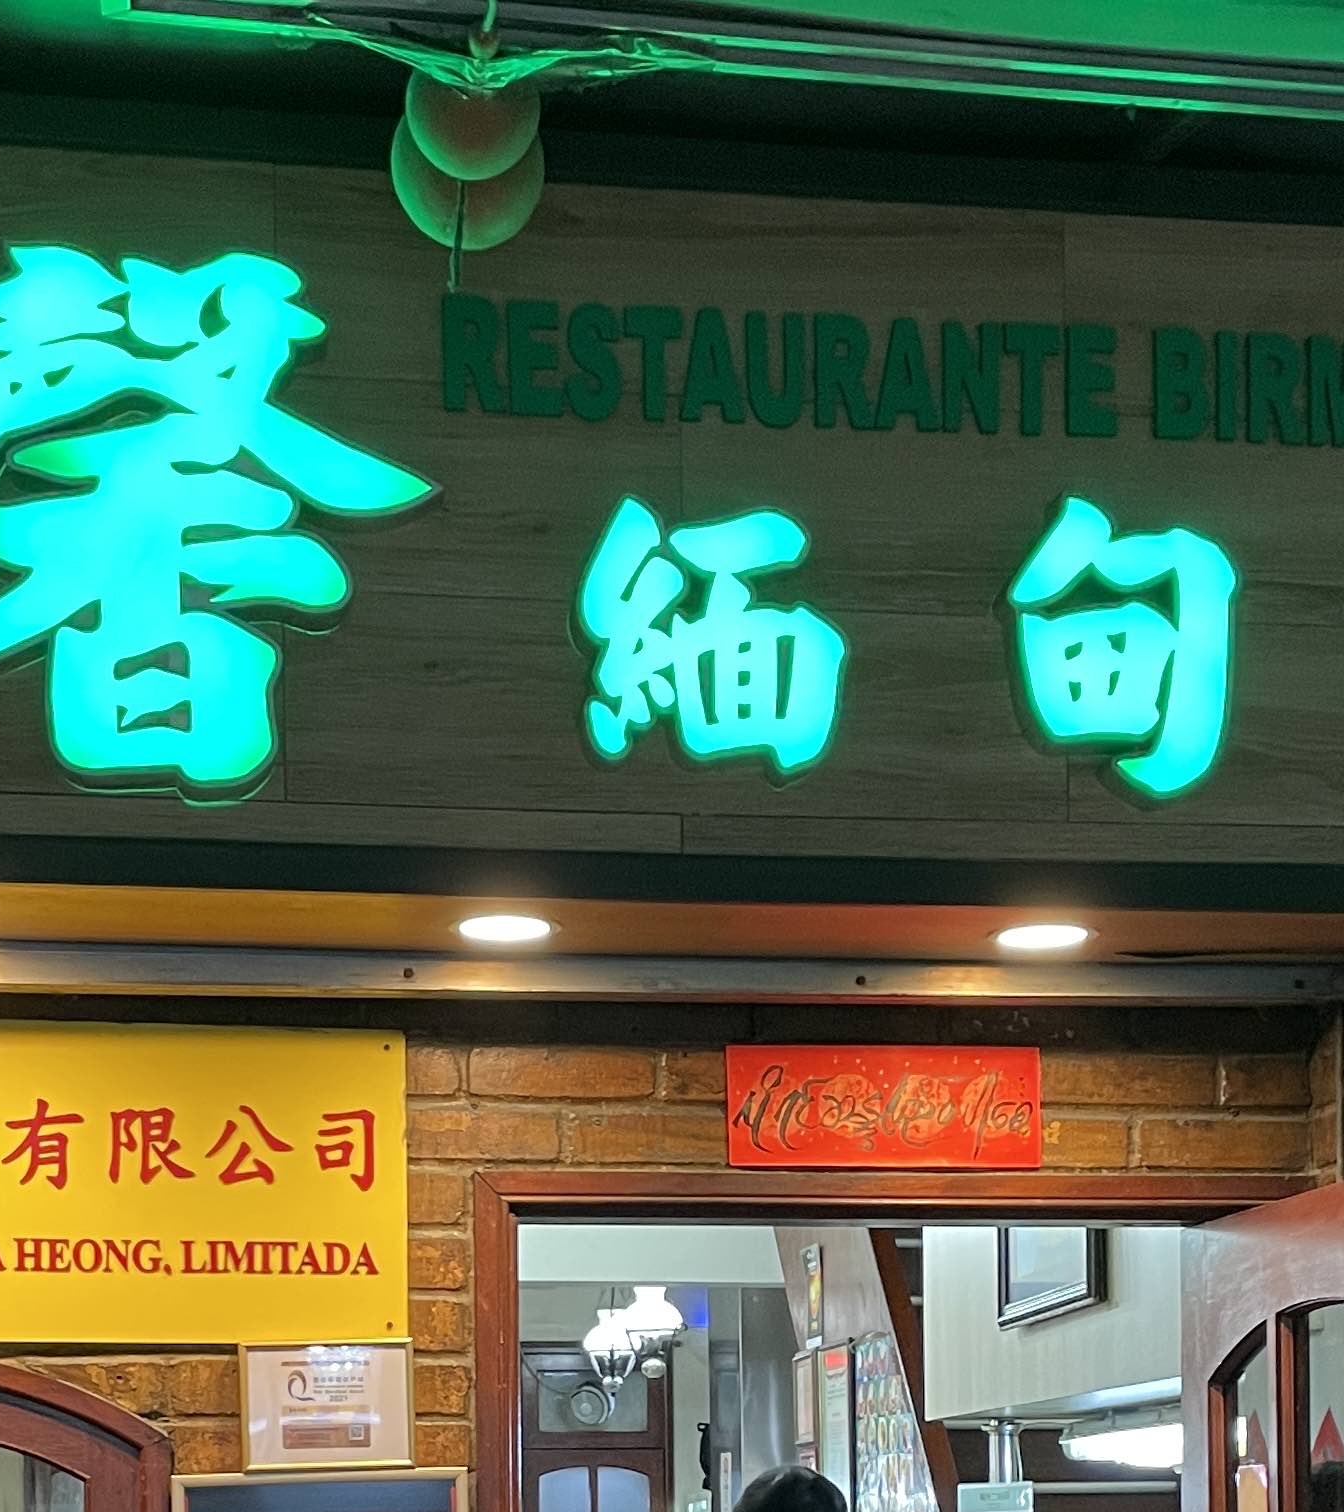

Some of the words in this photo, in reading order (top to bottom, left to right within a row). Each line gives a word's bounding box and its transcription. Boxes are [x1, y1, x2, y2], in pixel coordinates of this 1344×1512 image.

[440, 292, 1119, 441] RESTAURANTE
[12, 1236, 174, 1279] HEONG,
[179, 1237, 381, 1278] LIMITADA
